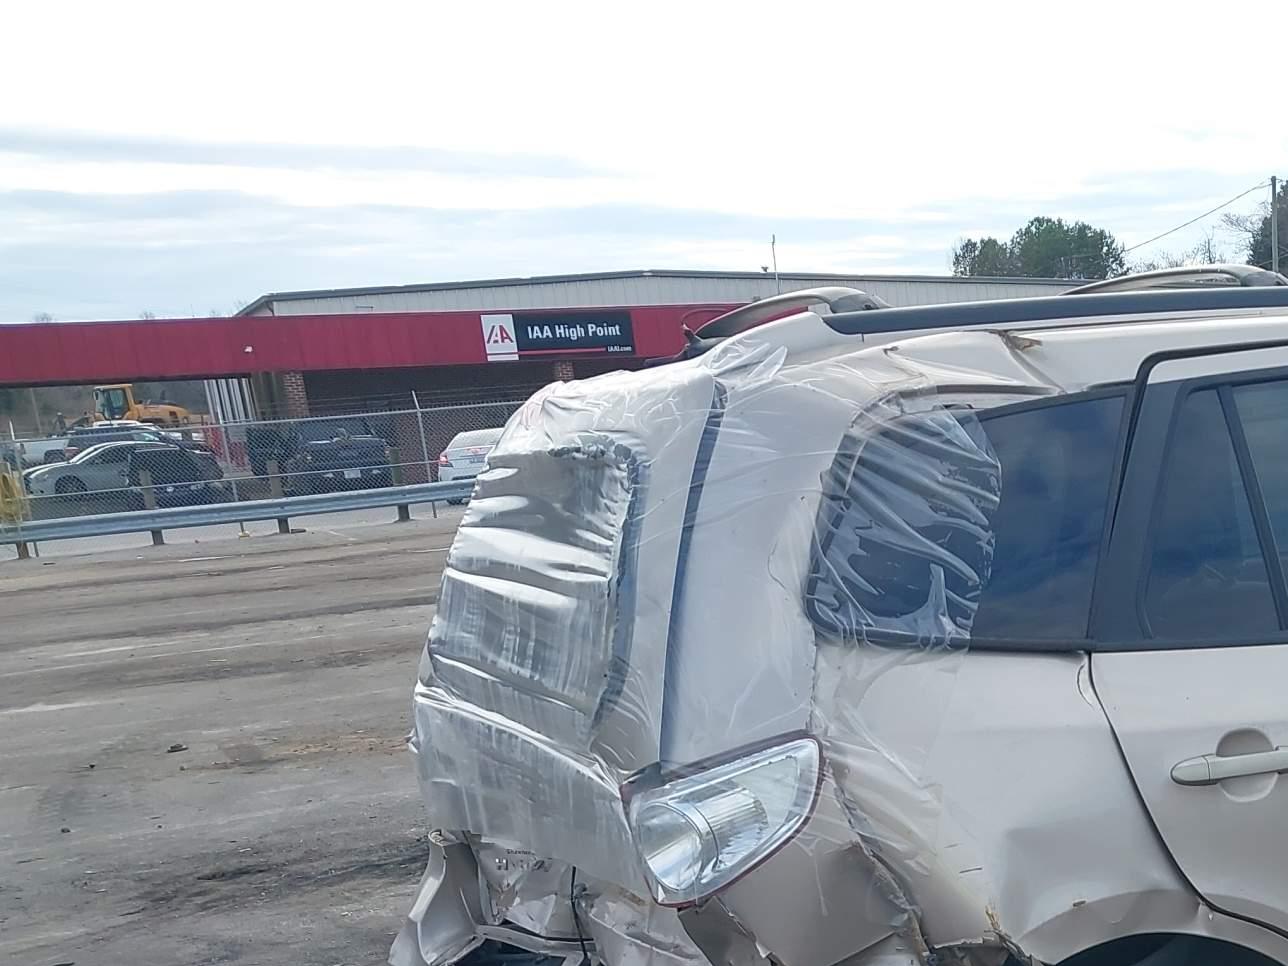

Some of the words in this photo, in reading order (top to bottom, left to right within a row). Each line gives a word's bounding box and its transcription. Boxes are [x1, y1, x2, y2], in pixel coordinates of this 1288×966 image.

[527, 324, 553, 339] IAA
[555, 323, 585, 341] High
[588, 322, 621, 338] Point
